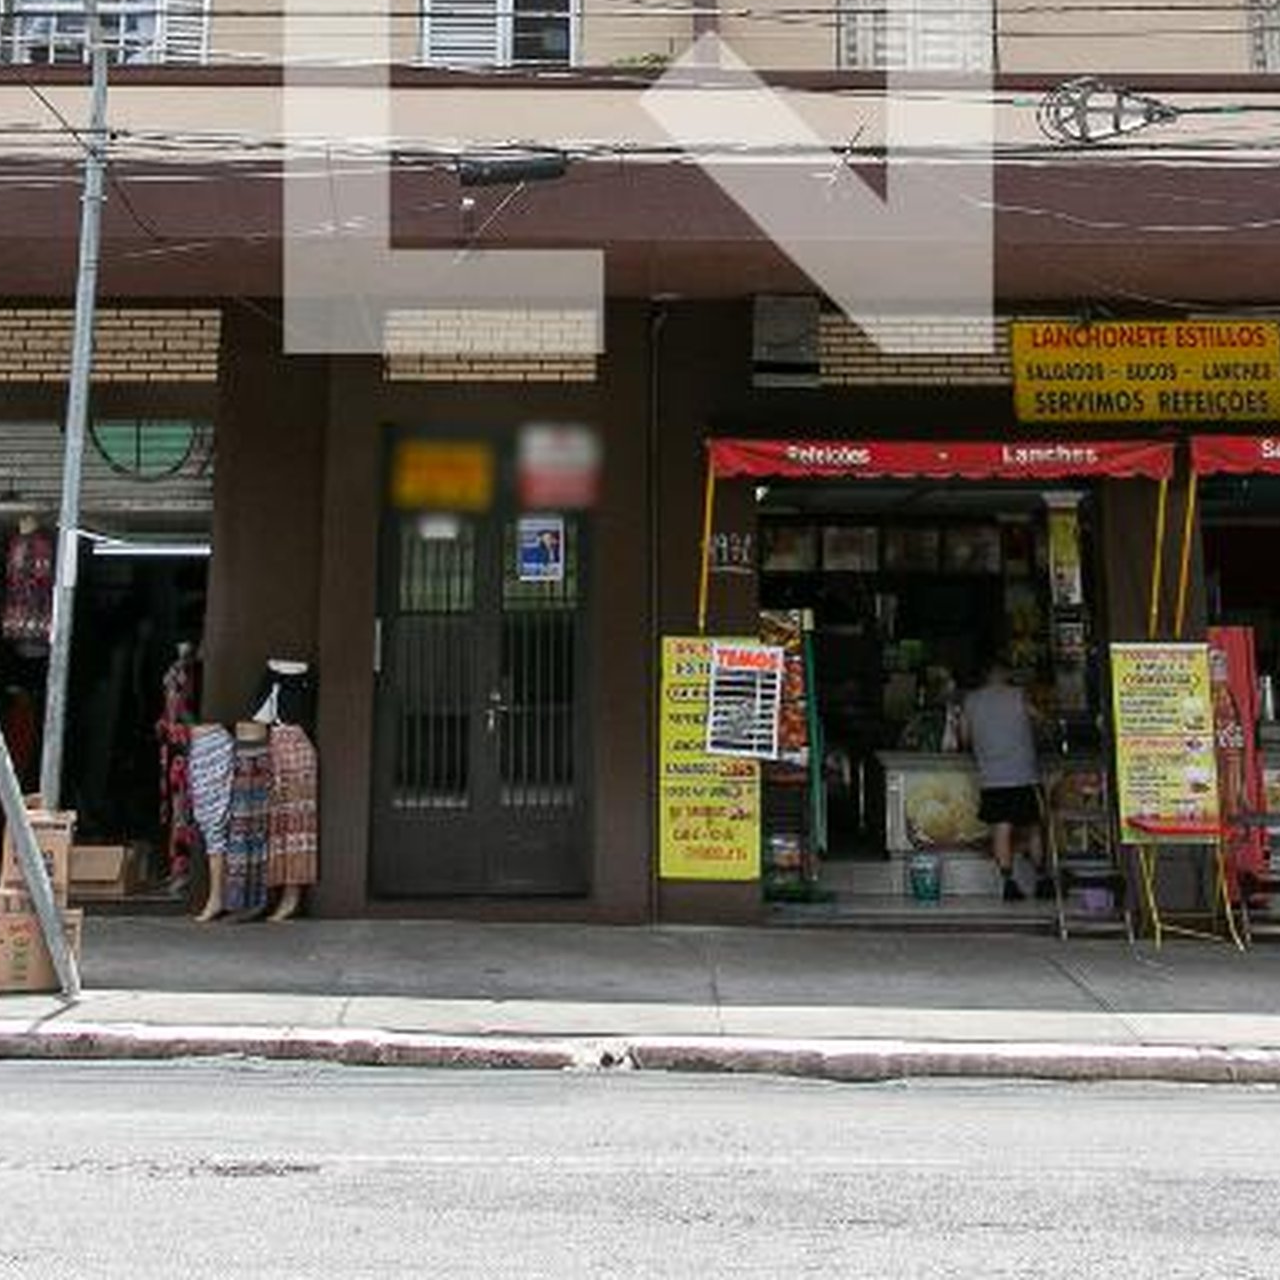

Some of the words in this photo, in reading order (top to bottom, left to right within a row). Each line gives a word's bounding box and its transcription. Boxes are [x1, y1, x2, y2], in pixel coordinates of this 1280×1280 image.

[1031, 325, 1168, 349] LANCHONETE
[1175, 325, 1266, 349] ESTILLOS
[1035, 389, 1145, 414] SERVIMOS
[1002, 444, 1099, 464] Lanches
